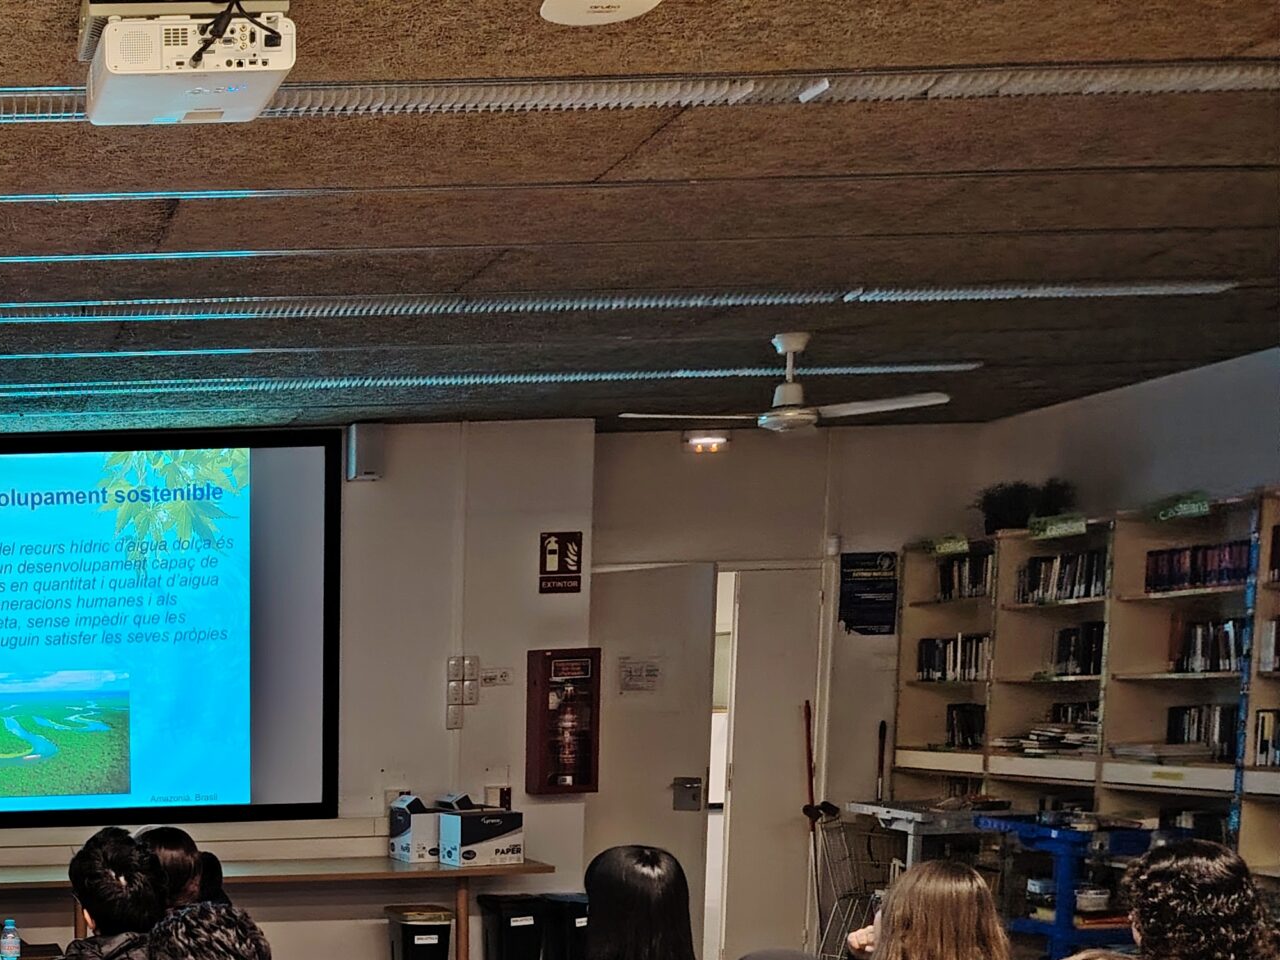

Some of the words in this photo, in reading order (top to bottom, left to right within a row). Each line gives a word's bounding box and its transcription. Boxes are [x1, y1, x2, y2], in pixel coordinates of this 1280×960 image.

[114, 484, 224, 505] sostenible
[19, 541, 66, 557] recurs
[114, 536, 168, 555] d'aigua
[171, 535, 213, 554] dolça
[216, 536, 234, 551] és
[17, 557, 147, 575] desenvolupament
[150, 556, 196, 573] capaç
[200, 555, 219, 569] de
[10, 579, 29, 592] en
[33, 575, 97, 594] quantitat
[100, 575, 105, 589] i
[109, 573, 162, 591] qualitat
[166, 573, 219, 590] d'aigua
[542, 579, 579, 589] EXTINTOR
[76, 593, 143, 609] humanes
[148, 592, 153, 607] i
[156, 592, 177, 607] als
[26, 614, 70, 628] sense
[74, 612, 129, 630] impedir
[132, 612, 161, 628] que
[165, 610, 186, 625] les
[44, 630, 98, 646] satisfer
[101, 629, 122, 644] les
[126, 630, 169, 643] seves
[173, 627, 228, 645] pròpies
[495, 848, 522, 856] PAPER
